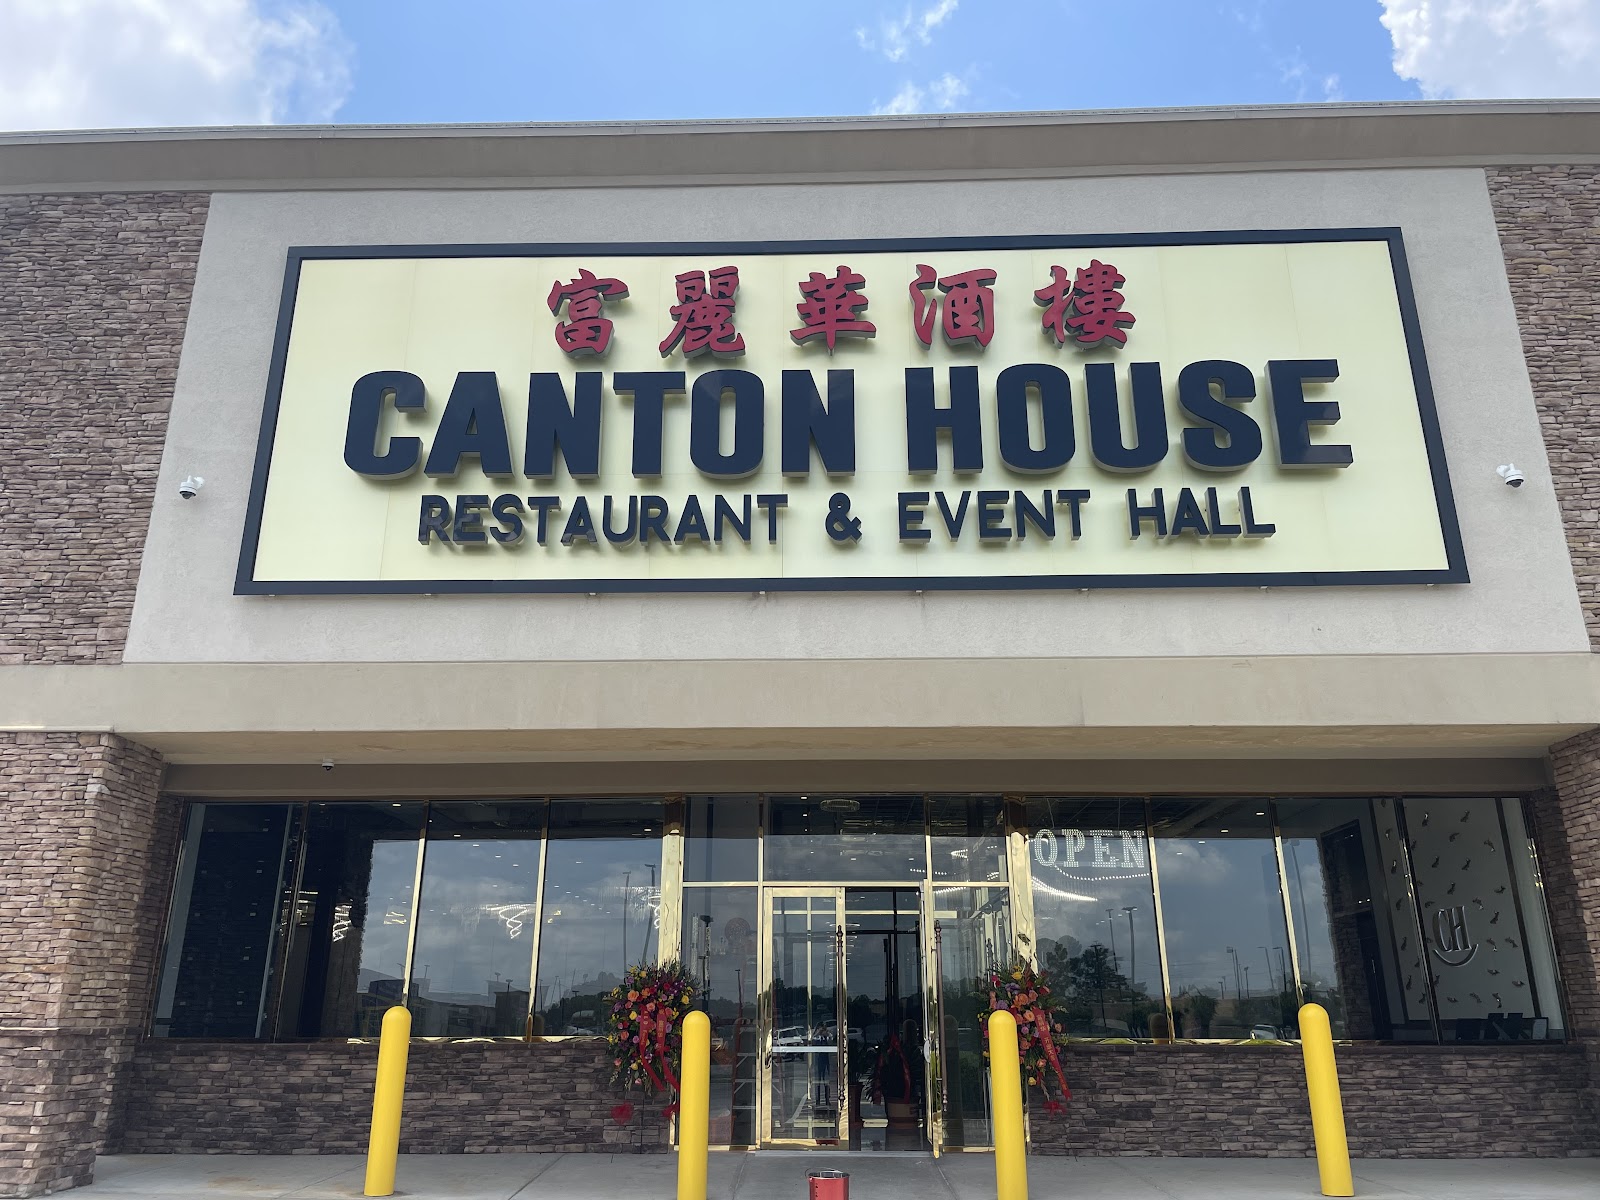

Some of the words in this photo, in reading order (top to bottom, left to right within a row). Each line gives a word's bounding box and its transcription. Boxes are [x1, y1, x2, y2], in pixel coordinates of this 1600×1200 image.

[547, 260, 1136, 358] 富麗華酒樓
[343, 368, 856, 479] CANTON
[905, 359, 1354, 474] HOUSE
[418, 493, 788, 546] RESTAURANT
[825, 492, 863, 543] &
[897, 489, 1091, 543] EVENT
[1125, 486, 1277, 540] HALL
[1034, 828, 1145, 868] OPEN
[1432, 905, 1472, 952] CH
